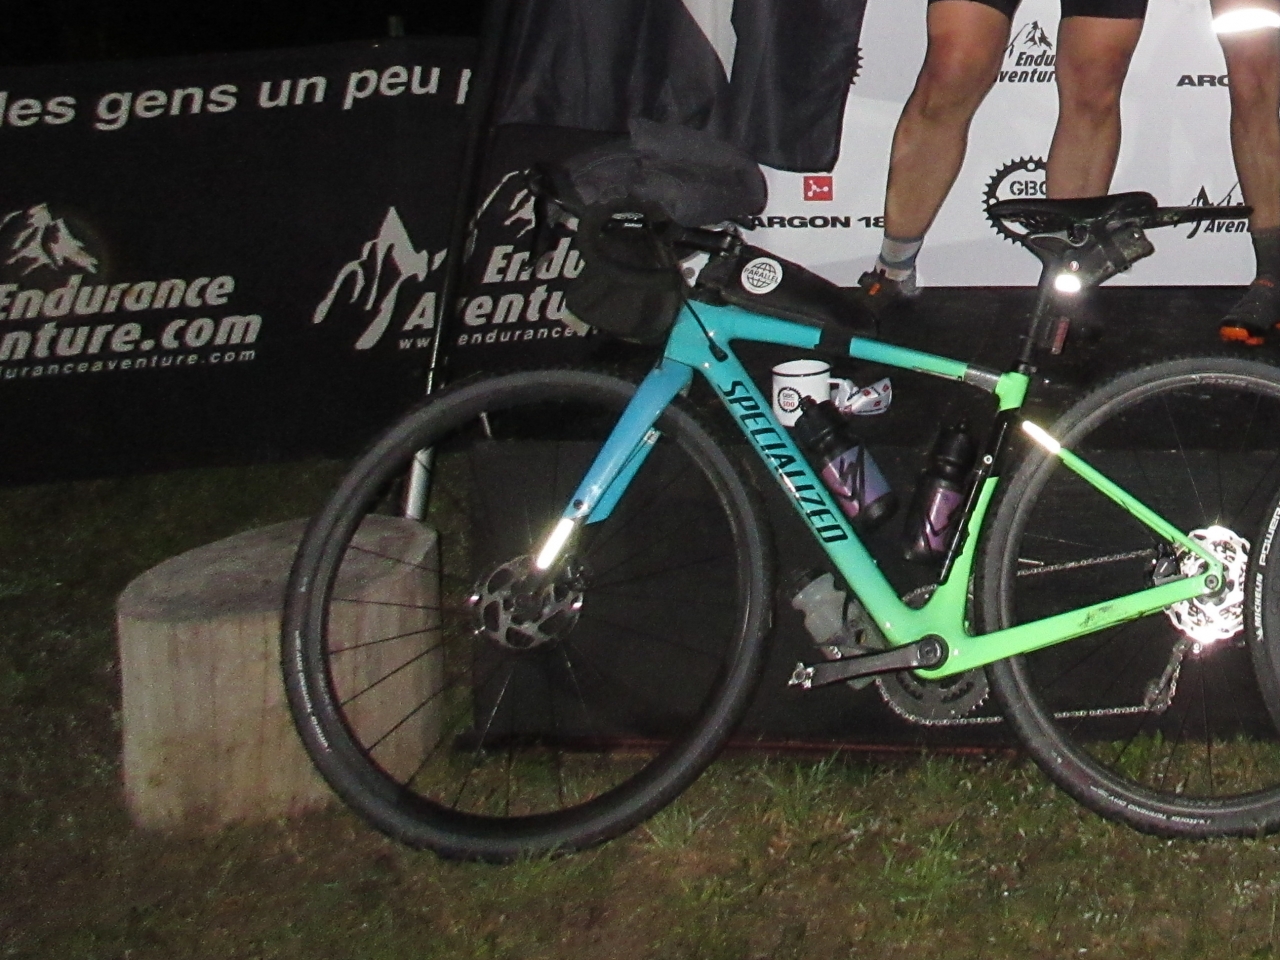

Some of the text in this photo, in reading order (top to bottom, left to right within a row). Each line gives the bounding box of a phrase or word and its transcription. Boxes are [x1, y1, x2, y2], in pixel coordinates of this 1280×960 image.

[95, 83, 238, 131] gens
[258, 75, 328, 109] un
[342, 65, 441, 110] peu
[750, 216, 851, 228] ARGON
[0, 274, 235, 320] Endurance
[743, 267, 780, 284] PARALLEL
[0, 314, 262, 360] nture.com
[717, 380, 849, 543] SPECIALIZED
[1254, 572, 1263, 627] MICHELIN
